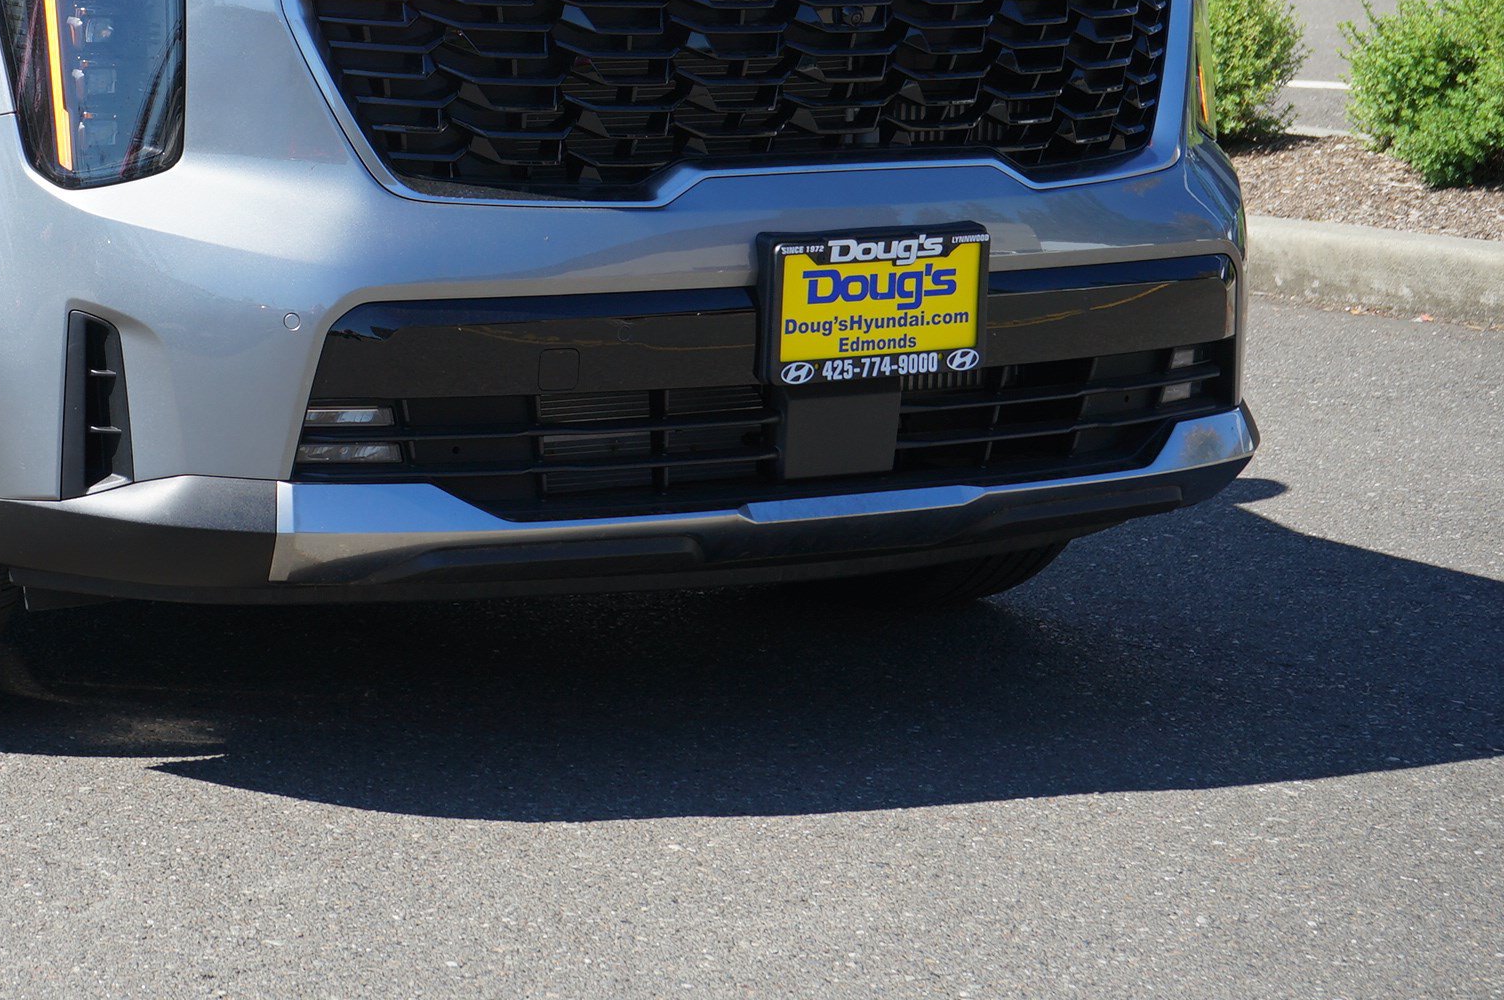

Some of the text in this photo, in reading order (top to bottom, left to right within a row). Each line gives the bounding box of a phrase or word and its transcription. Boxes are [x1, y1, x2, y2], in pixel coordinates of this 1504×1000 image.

[781, 245, 825, 255] SINCE 1972
[828, 234, 944, 265] Doug's
[951, 233, 990, 245] LYNNWOOD
[802, 263, 957, 310] Doug's
[784, 311, 969, 337] Doug'sHyundai.com
[838, 334, 917, 353] Edmonds
[822, 352, 938, 381] 425-774-9000
